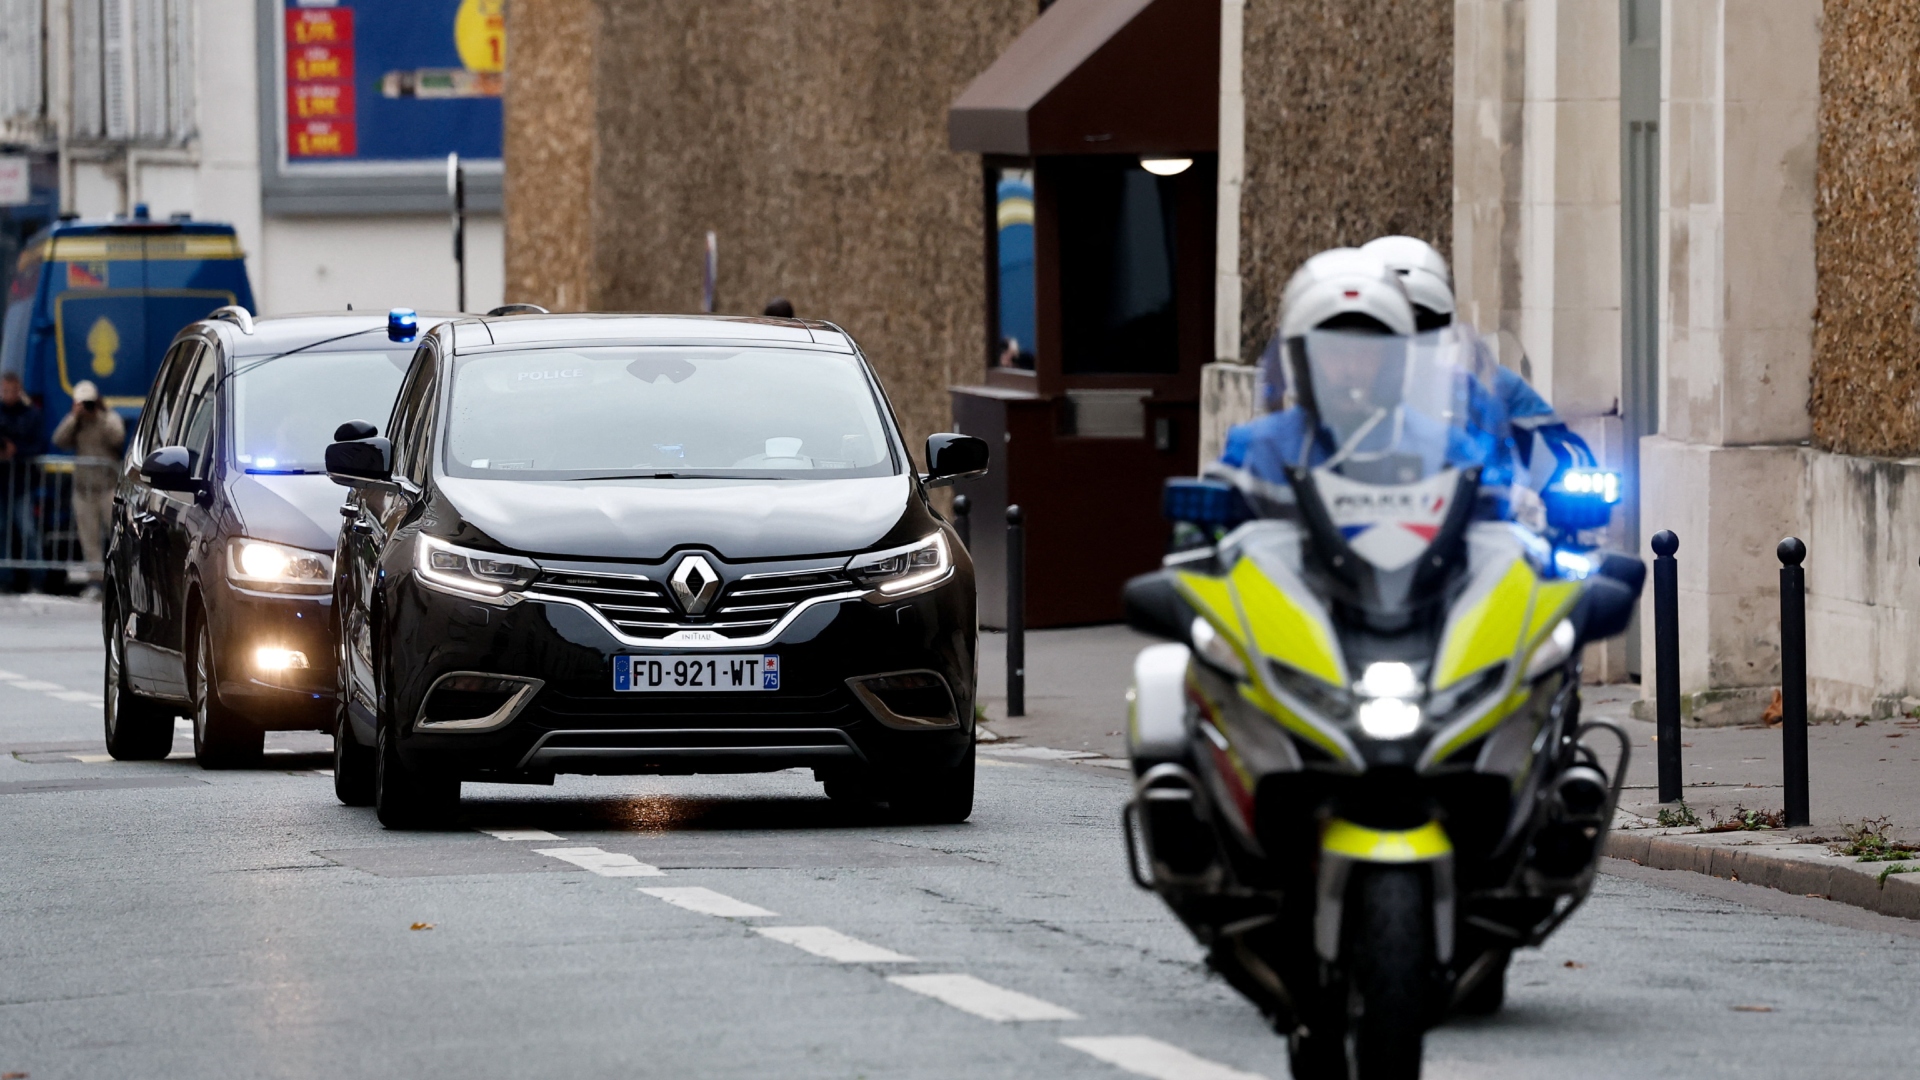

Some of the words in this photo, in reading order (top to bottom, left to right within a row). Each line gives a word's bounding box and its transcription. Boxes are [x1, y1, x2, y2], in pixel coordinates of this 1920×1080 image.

[517, 368, 583, 381] POLICE
[619, 675, 626, 684] F
[633, 659, 759, 687] FD-921-WT
[764, 673, 778, 686] 75
